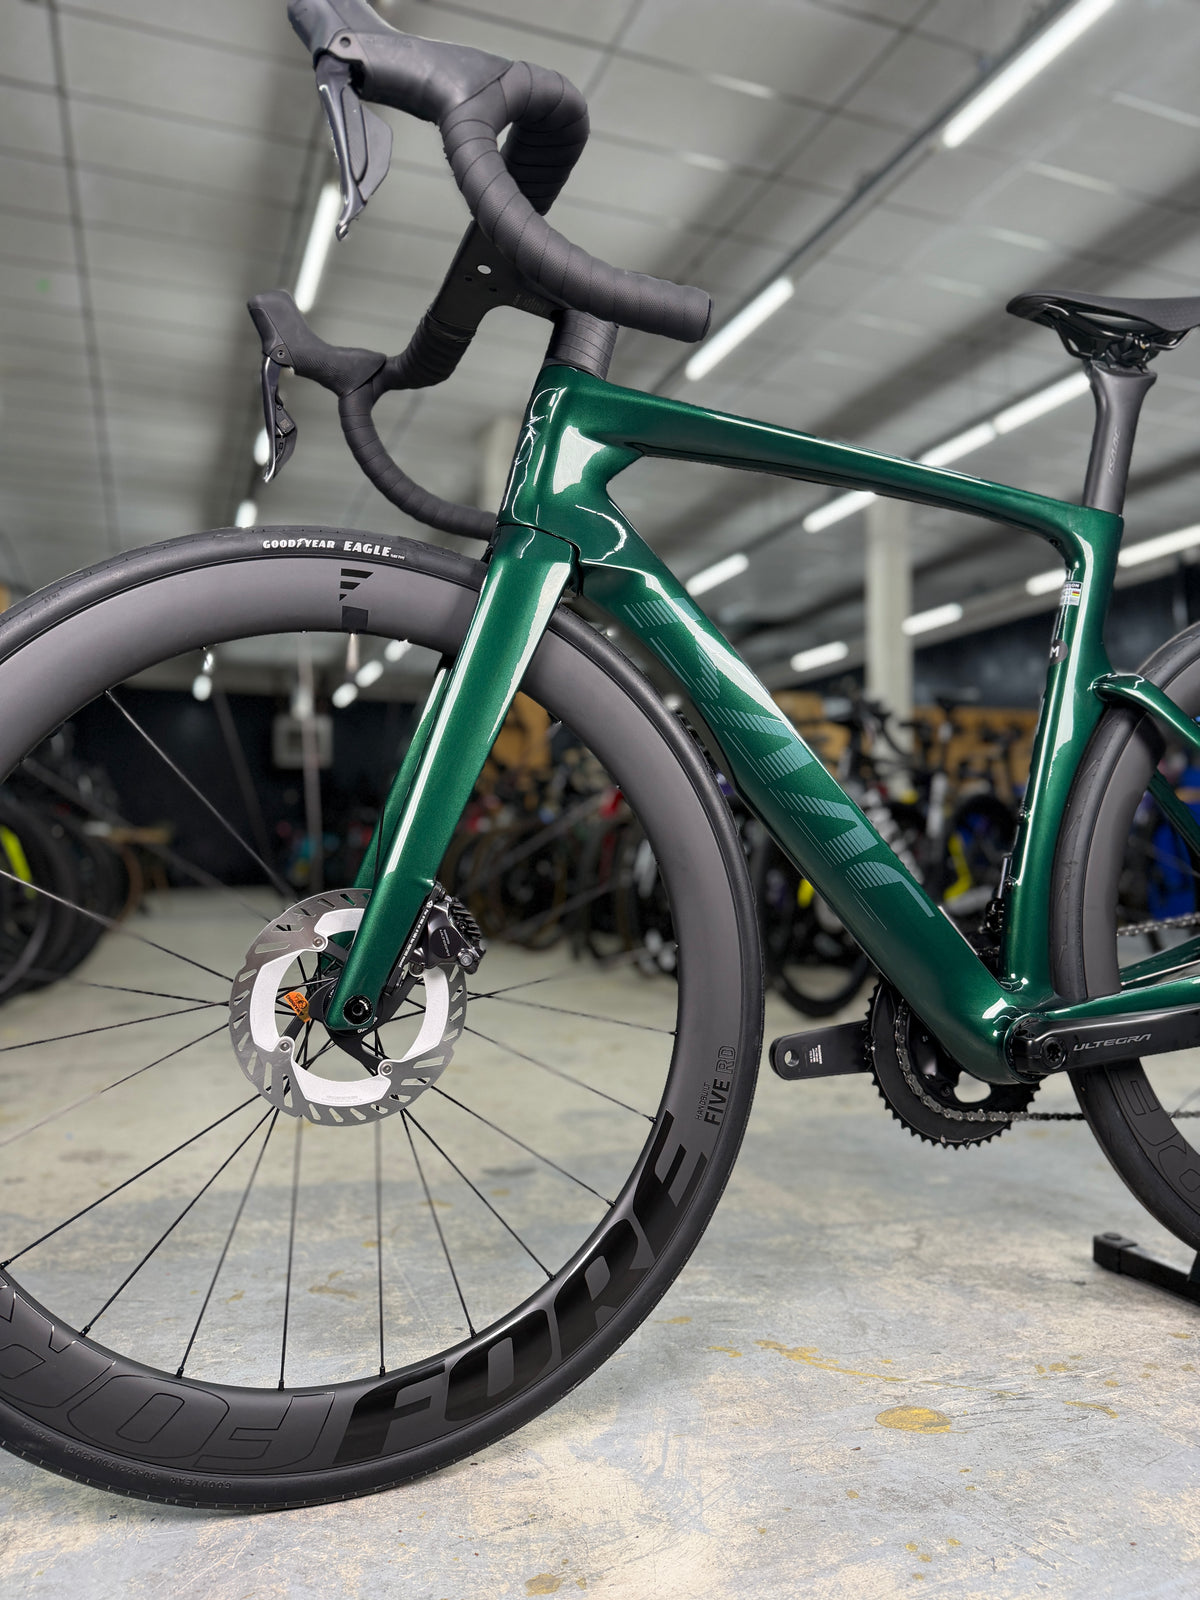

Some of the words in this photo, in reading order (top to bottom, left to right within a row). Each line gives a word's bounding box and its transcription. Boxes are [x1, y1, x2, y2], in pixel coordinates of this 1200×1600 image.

[262, 538, 336, 549] GOODYEAR
[343, 541, 392, 557] EAGLE
[1049, 645, 1060, 659] M
[1073, 1033, 1152, 1052] ULTEGRA
[715, 1045, 736, 1075] RD
[696, 1082, 711, 1121] HANDBUILT
[704, 1078, 731, 1126] FIVE
[333, 1110, 708, 1465] FORE
